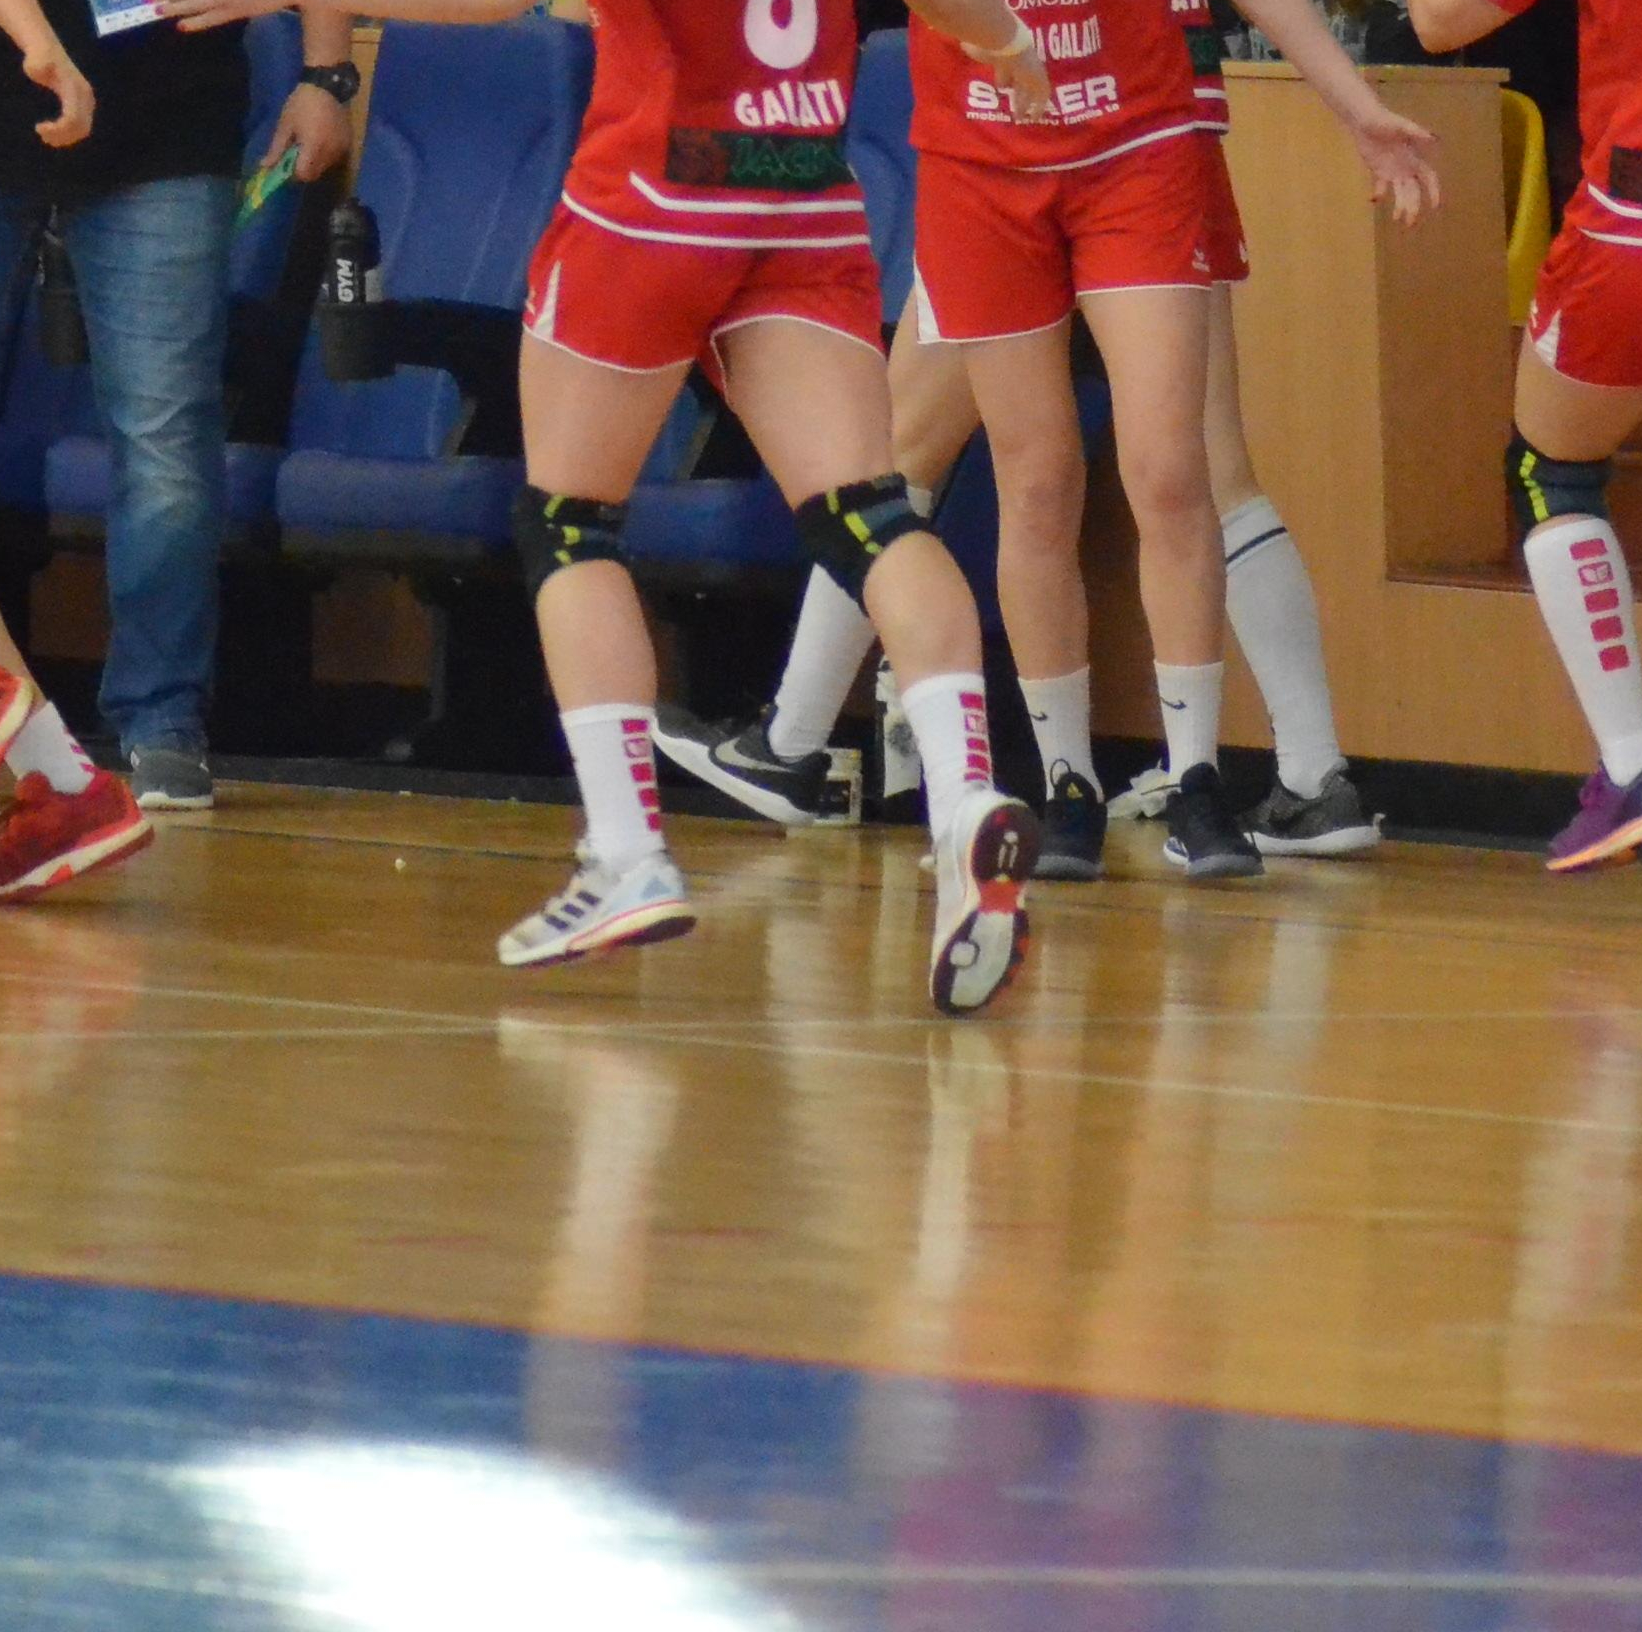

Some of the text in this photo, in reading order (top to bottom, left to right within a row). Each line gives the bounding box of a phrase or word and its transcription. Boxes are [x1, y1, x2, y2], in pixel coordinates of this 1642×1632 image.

[734, 78, 847, 129] GALATI
[967, 75, 1118, 116] STER
[336, 258, 355, 303] GYM
